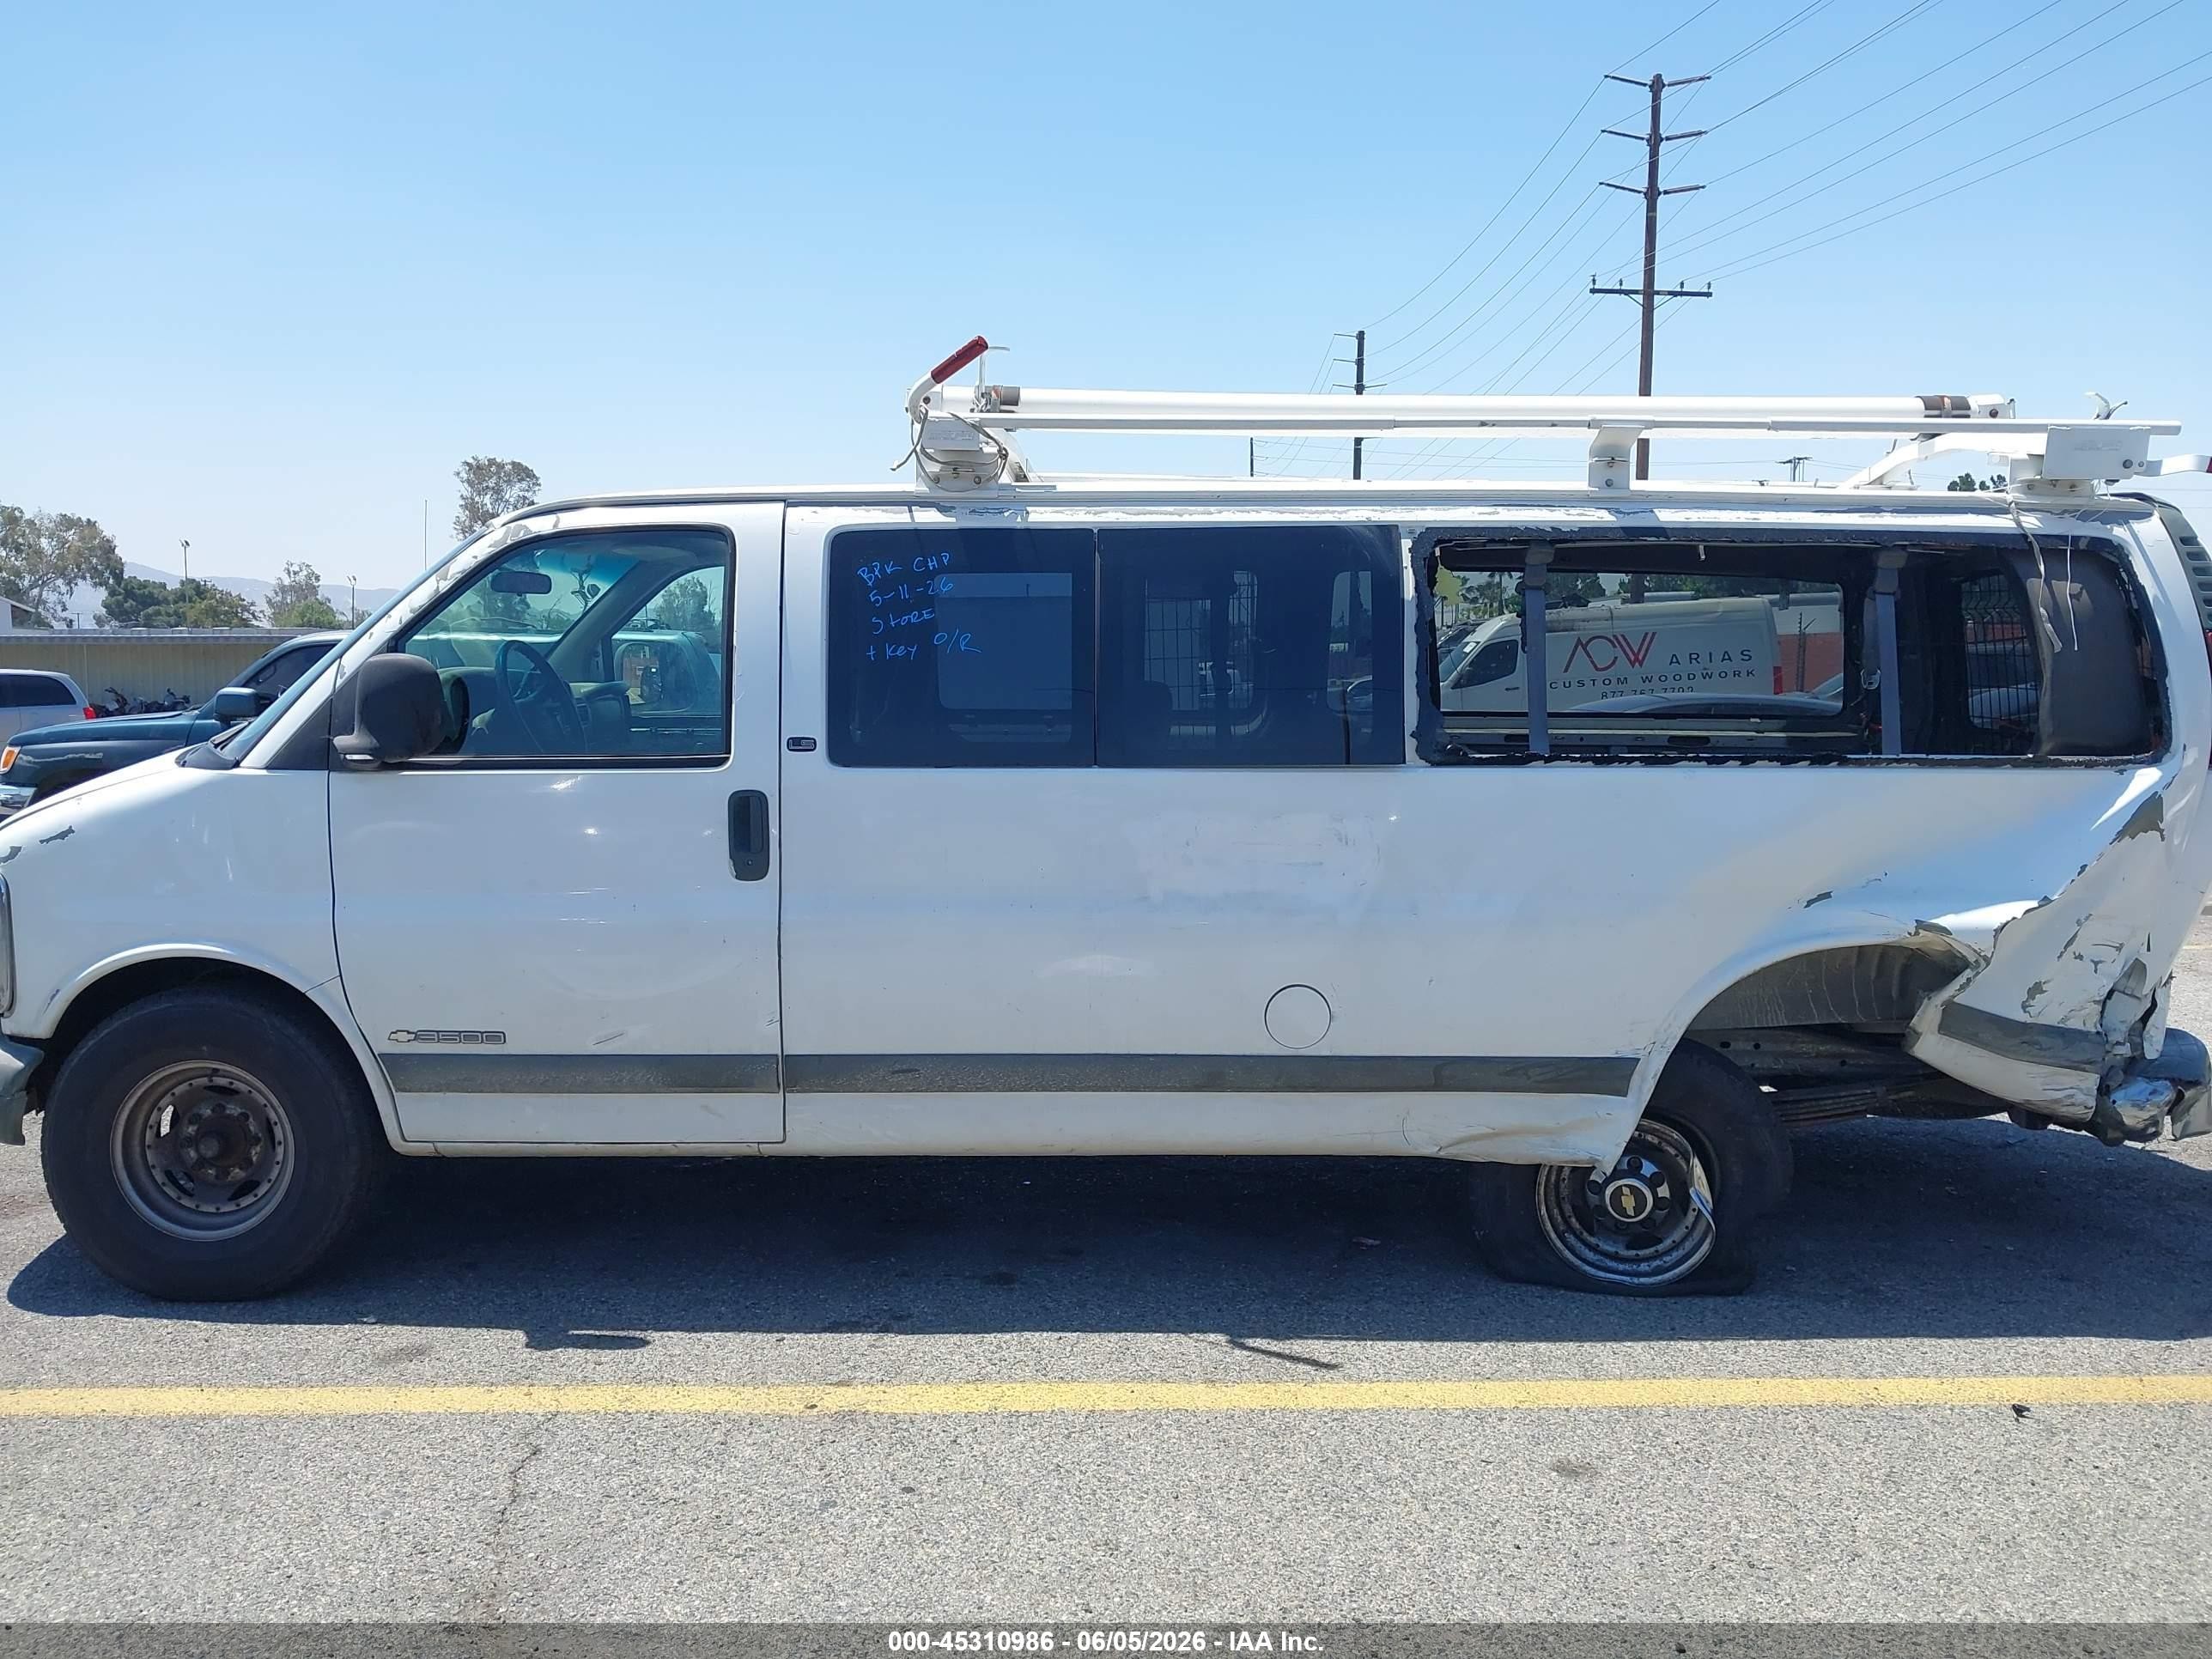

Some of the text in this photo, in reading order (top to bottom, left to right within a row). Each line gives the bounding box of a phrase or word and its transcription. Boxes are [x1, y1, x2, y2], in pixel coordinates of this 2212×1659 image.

[913, 552, 951, 572] CHP
[1668, 648, 1753, 666] ARIAS
[1549, 668, 1757, 690] CUSTOM WOODWORK
[788, 738, 815, 750] LS
[416, 1030, 507, 1045] 3500
